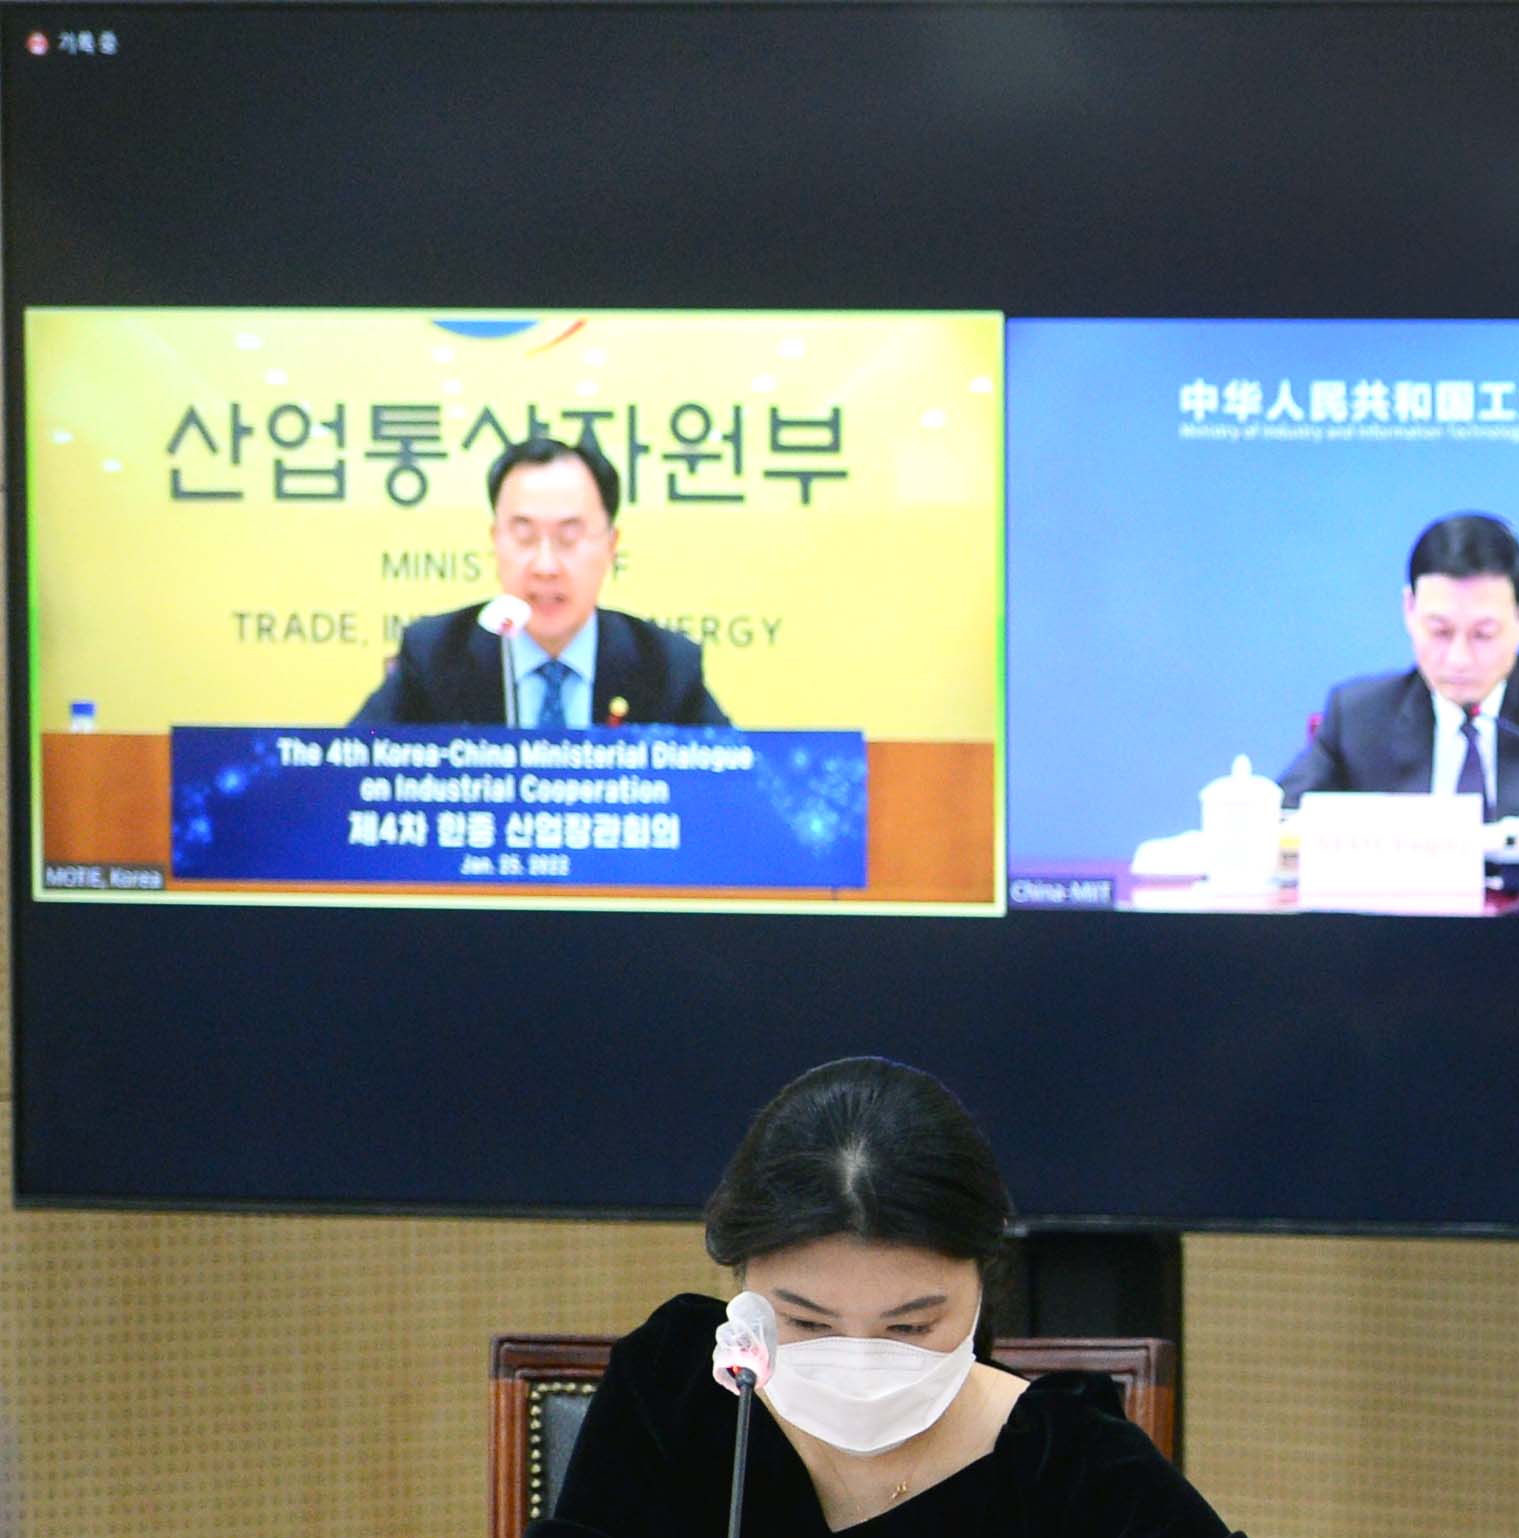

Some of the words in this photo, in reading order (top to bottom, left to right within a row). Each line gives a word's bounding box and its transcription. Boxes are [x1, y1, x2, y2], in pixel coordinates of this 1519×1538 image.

[277, 737, 323, 767] The
[326, 738, 371, 767] 4th
[372, 738, 517, 768] Korea-China
[520, 738, 649, 769] Ministerial
[651, 739, 754, 772] Dialogue
[360, 776, 391, 802] on
[394, 773, 516, 803] Industrial
[519, 773, 670, 805] Cooperation
